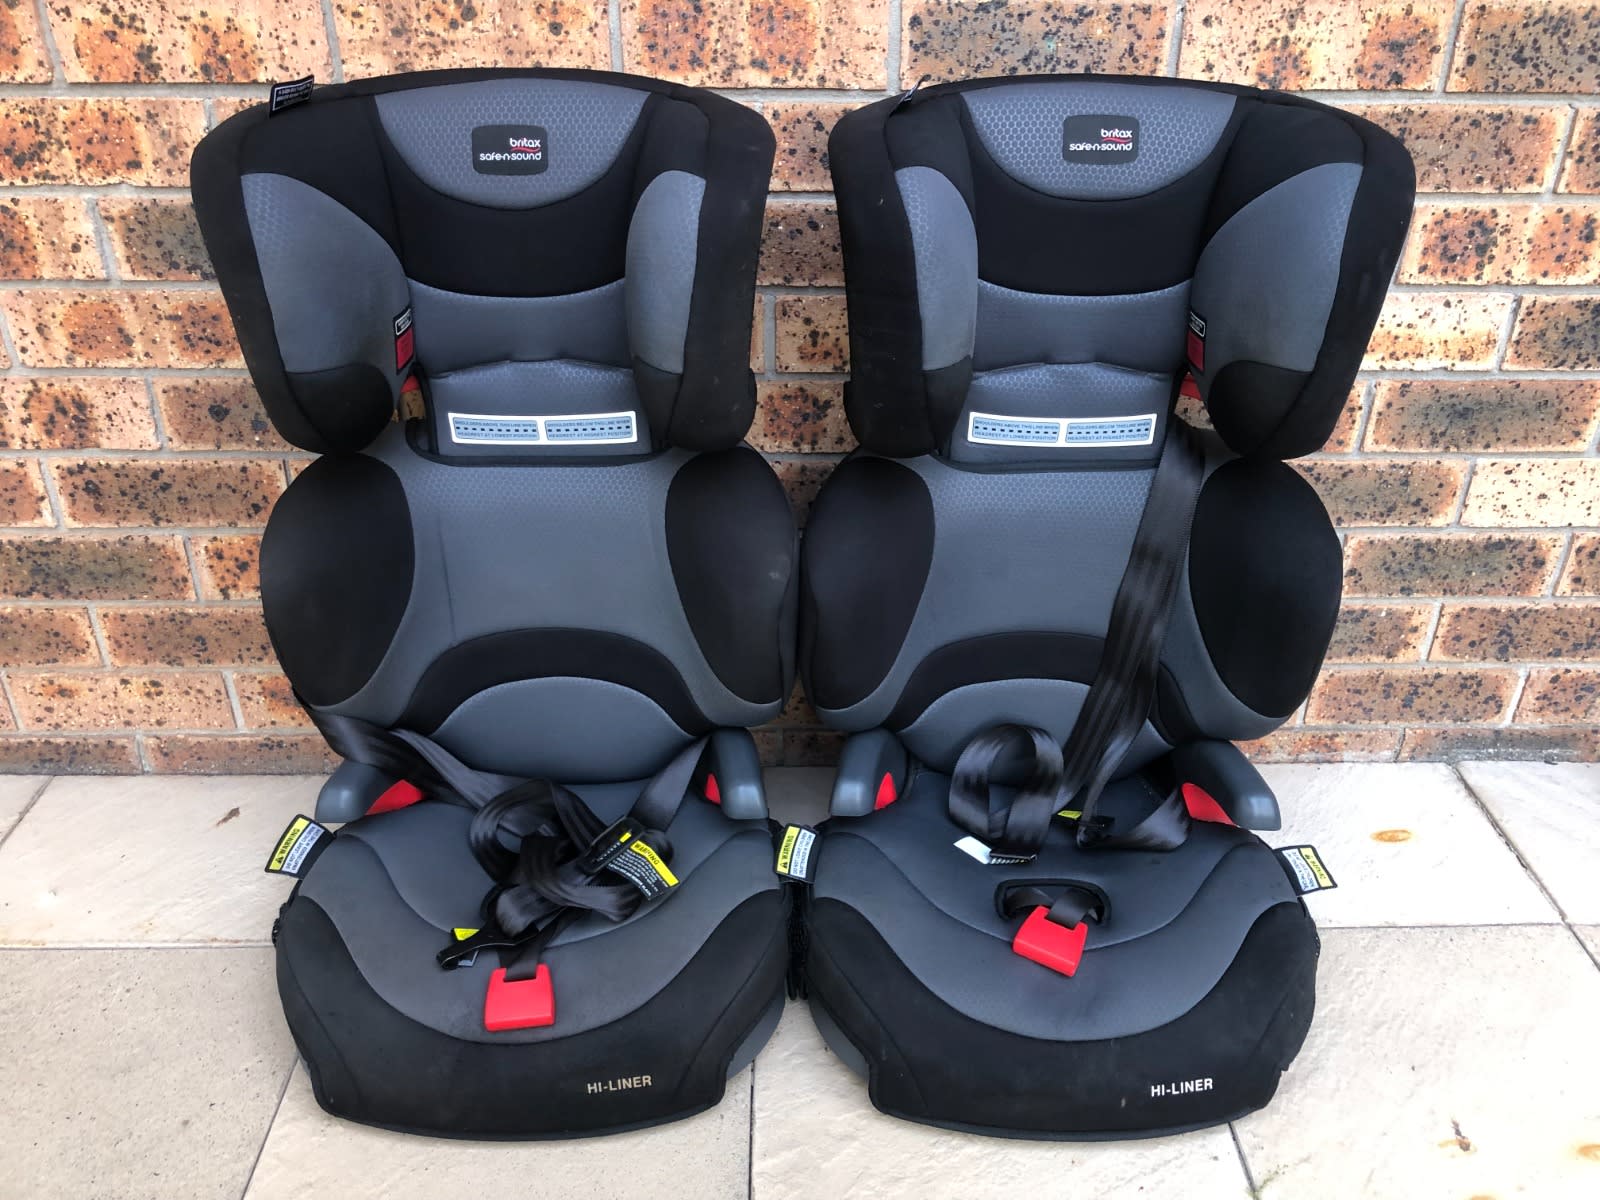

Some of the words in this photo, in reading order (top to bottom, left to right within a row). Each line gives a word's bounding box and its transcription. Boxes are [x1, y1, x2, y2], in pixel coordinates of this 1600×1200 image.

[1100, 128, 1133, 138] britax
[510, 137, 541, 148] britax
[587, 1075, 652, 1094] HI-LINER
[1151, 1077, 1213, 1097] HI-LINER
